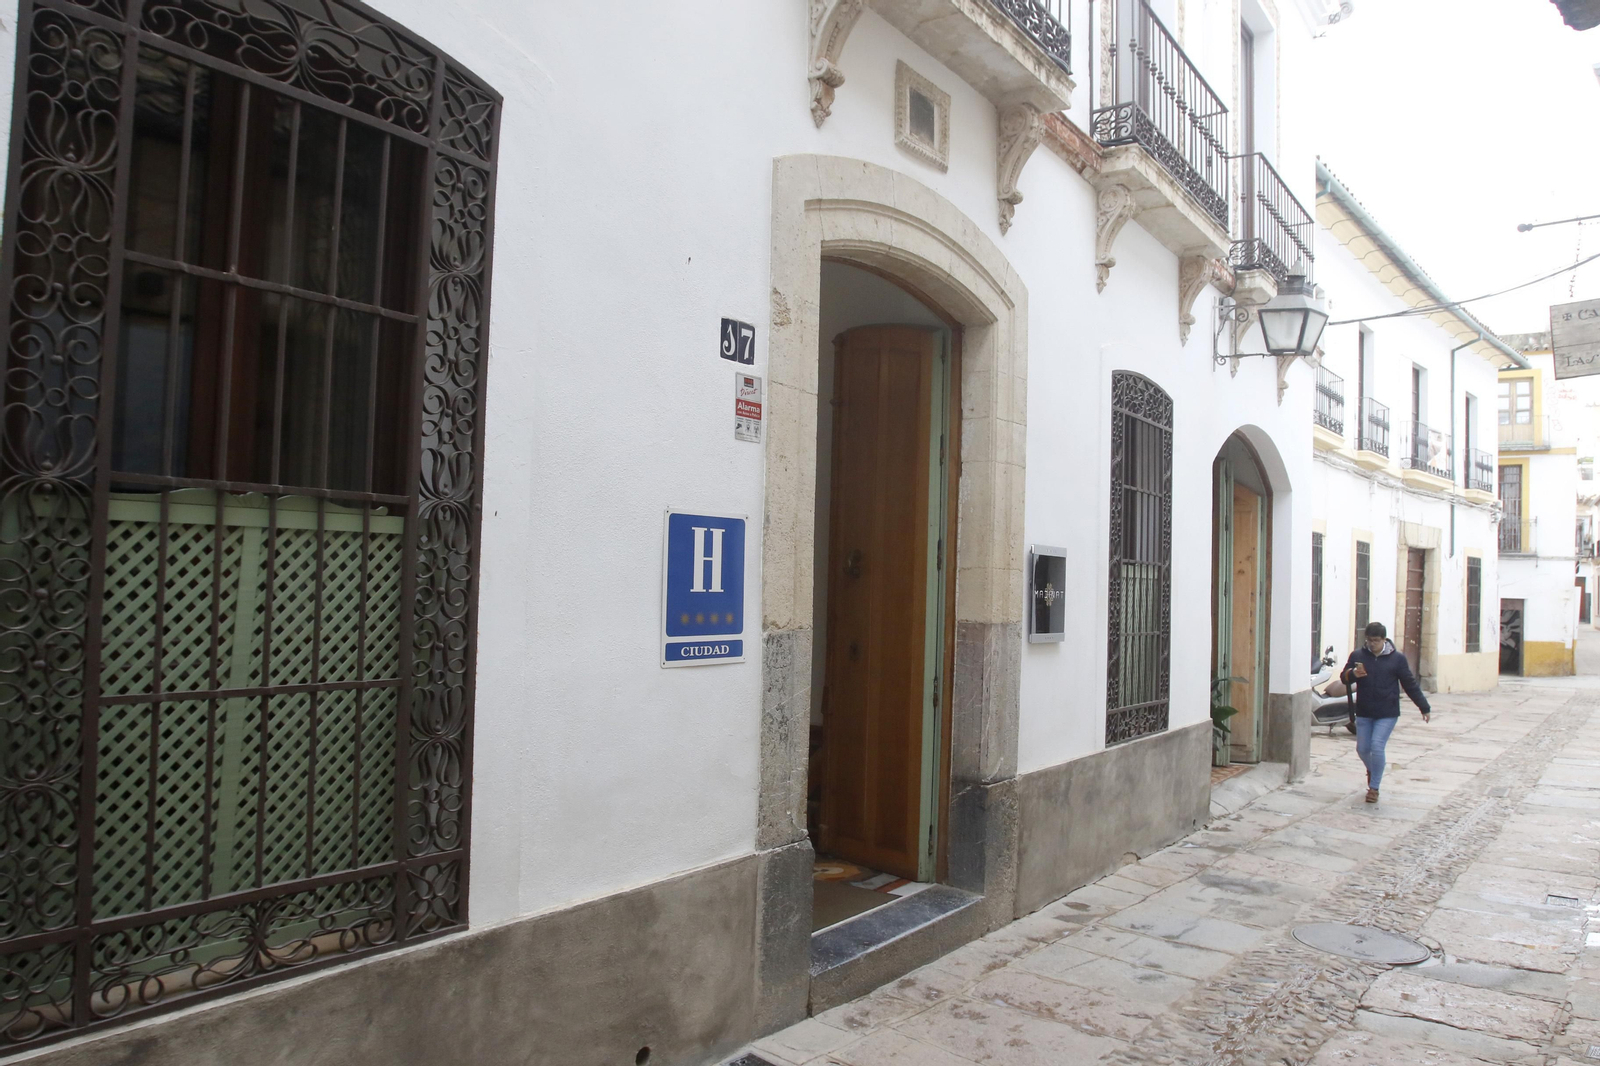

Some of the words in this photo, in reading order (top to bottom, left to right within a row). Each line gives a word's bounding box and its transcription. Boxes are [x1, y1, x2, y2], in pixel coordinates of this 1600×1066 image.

[737, 401, 760, 413] Alarma
[690, 526, 726, 593] H
[680, 645, 730, 657] CIUDAD
